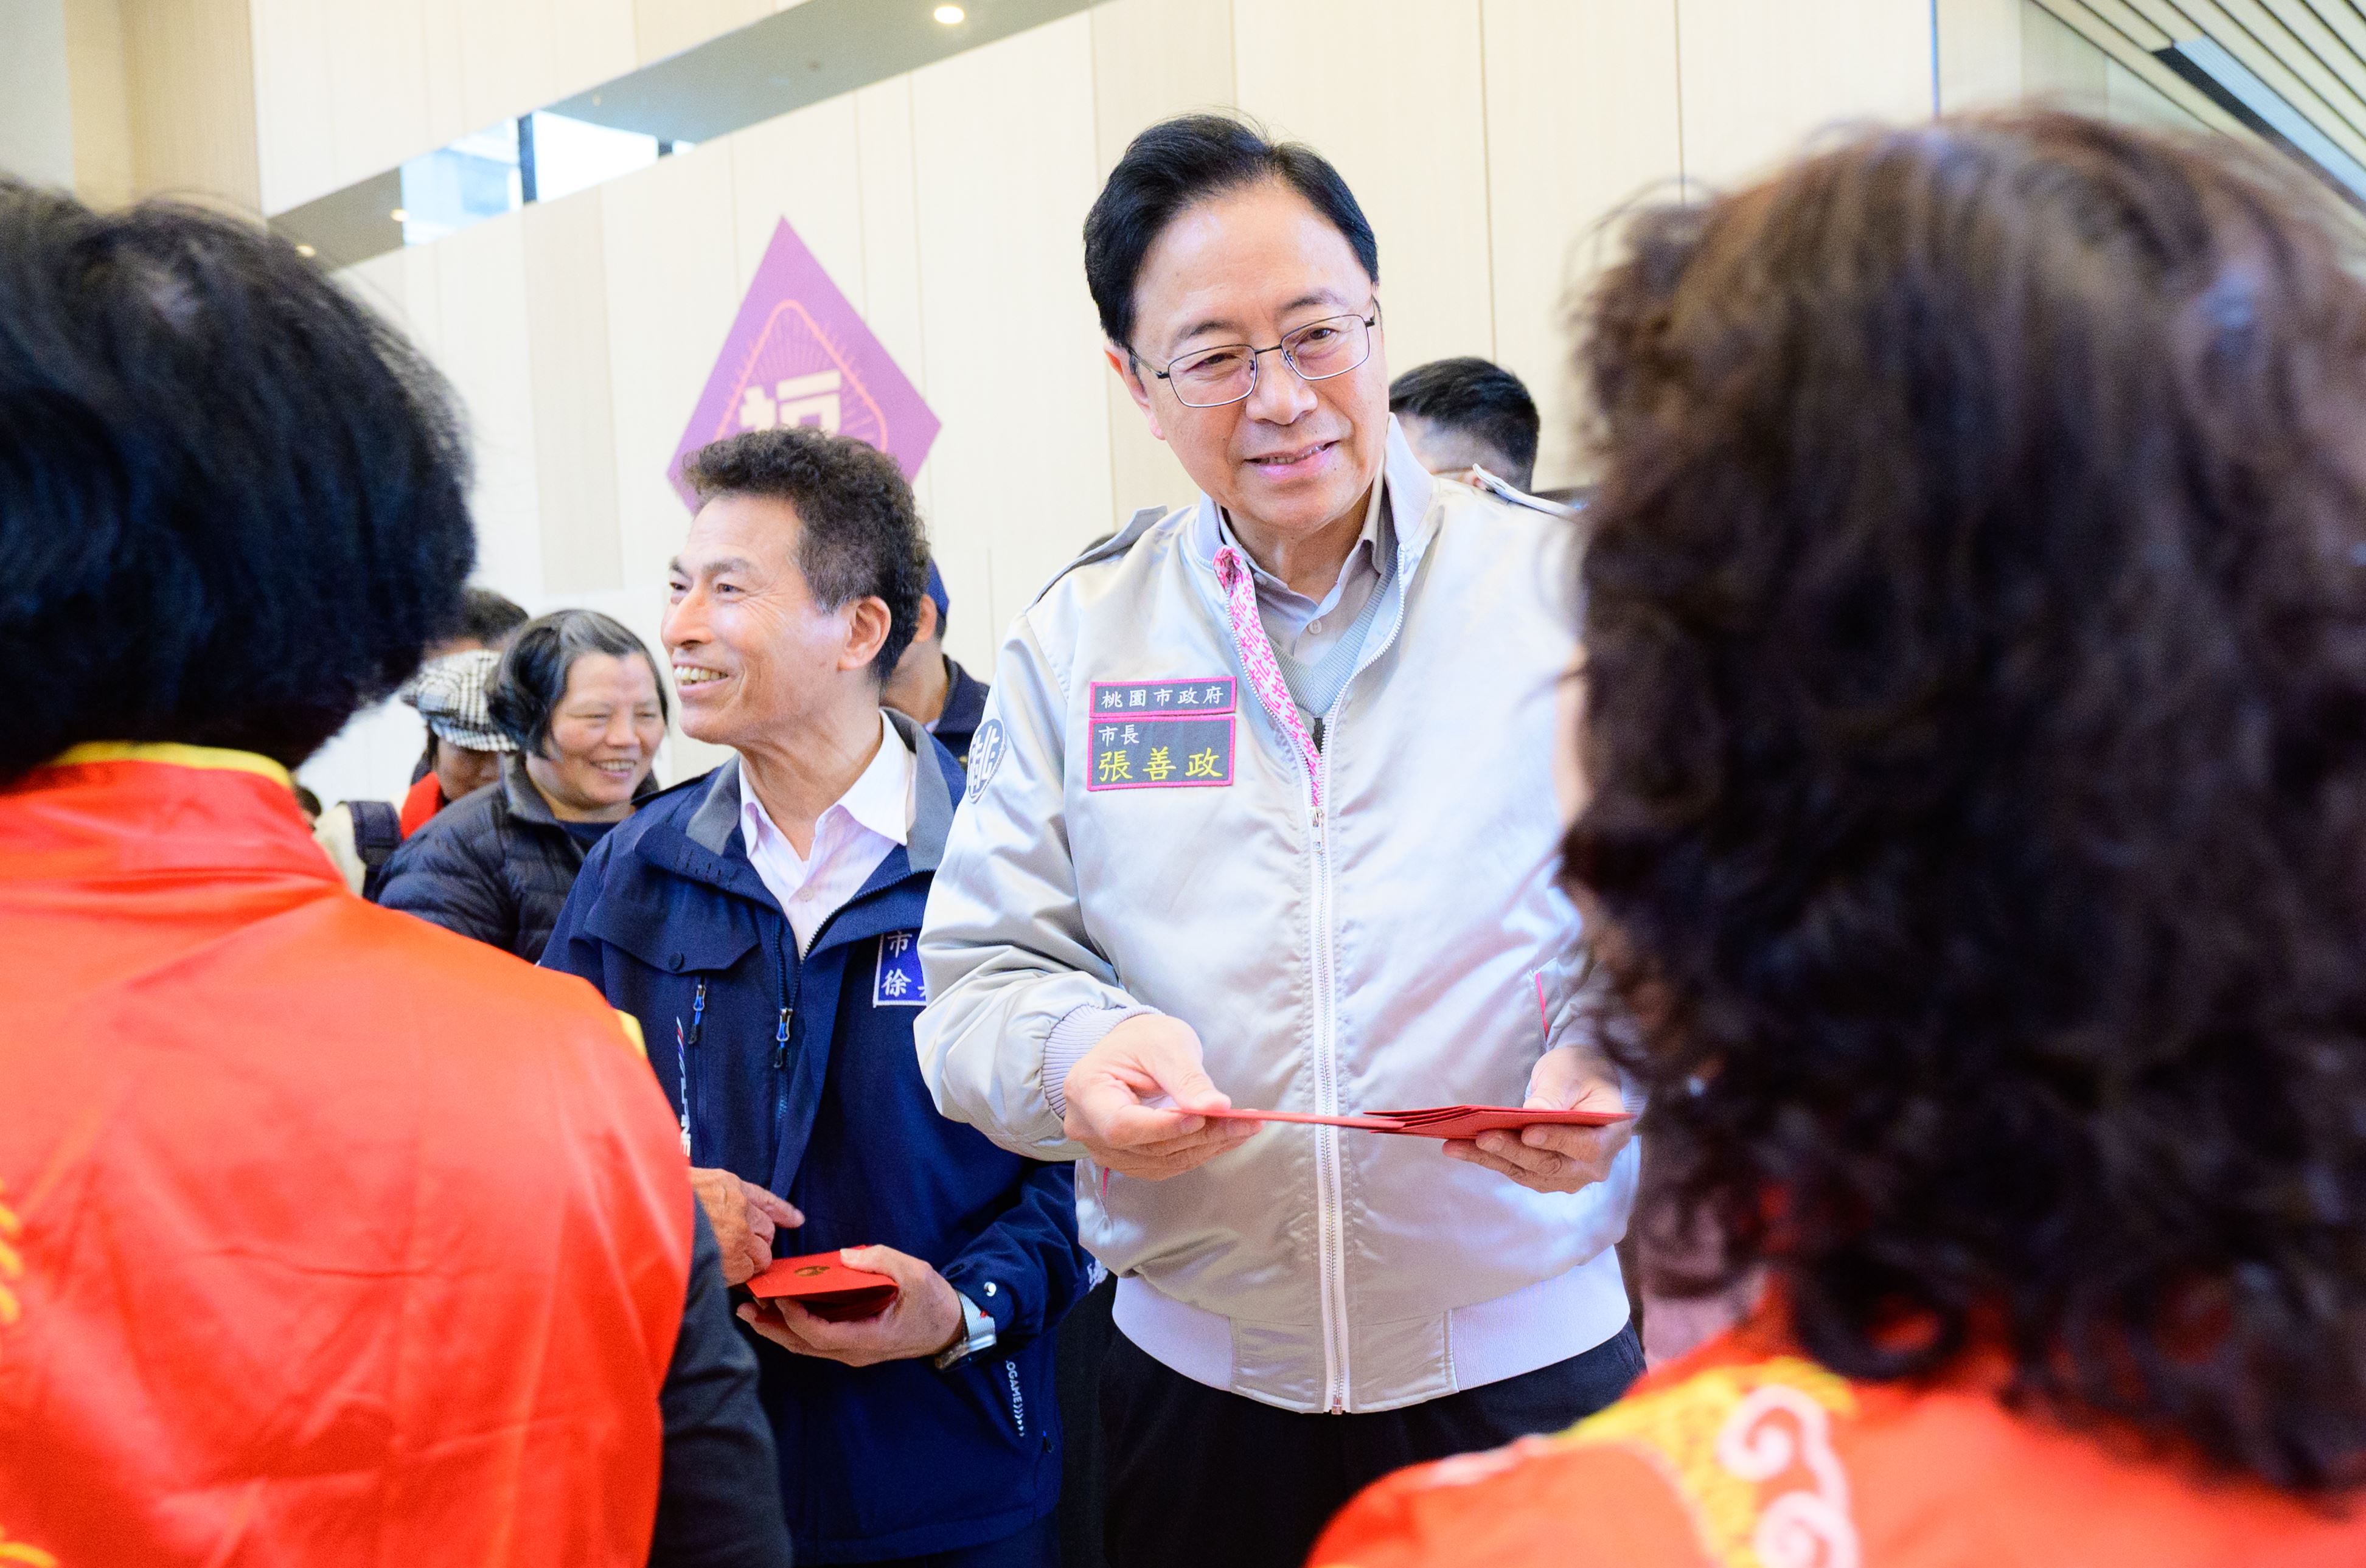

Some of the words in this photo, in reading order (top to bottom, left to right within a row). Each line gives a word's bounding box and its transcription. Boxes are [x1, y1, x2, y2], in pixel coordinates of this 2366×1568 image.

[1101, 685, 1224, 709] 桃園市政府
[1098, 724, 1140, 747] 市長
[1098, 746, 1223, 783] 張善政
[887, 931, 913, 958] 市
[881, 968, 925, 997] 徐
[1006, 1360, 1023, 1404] OGAME
